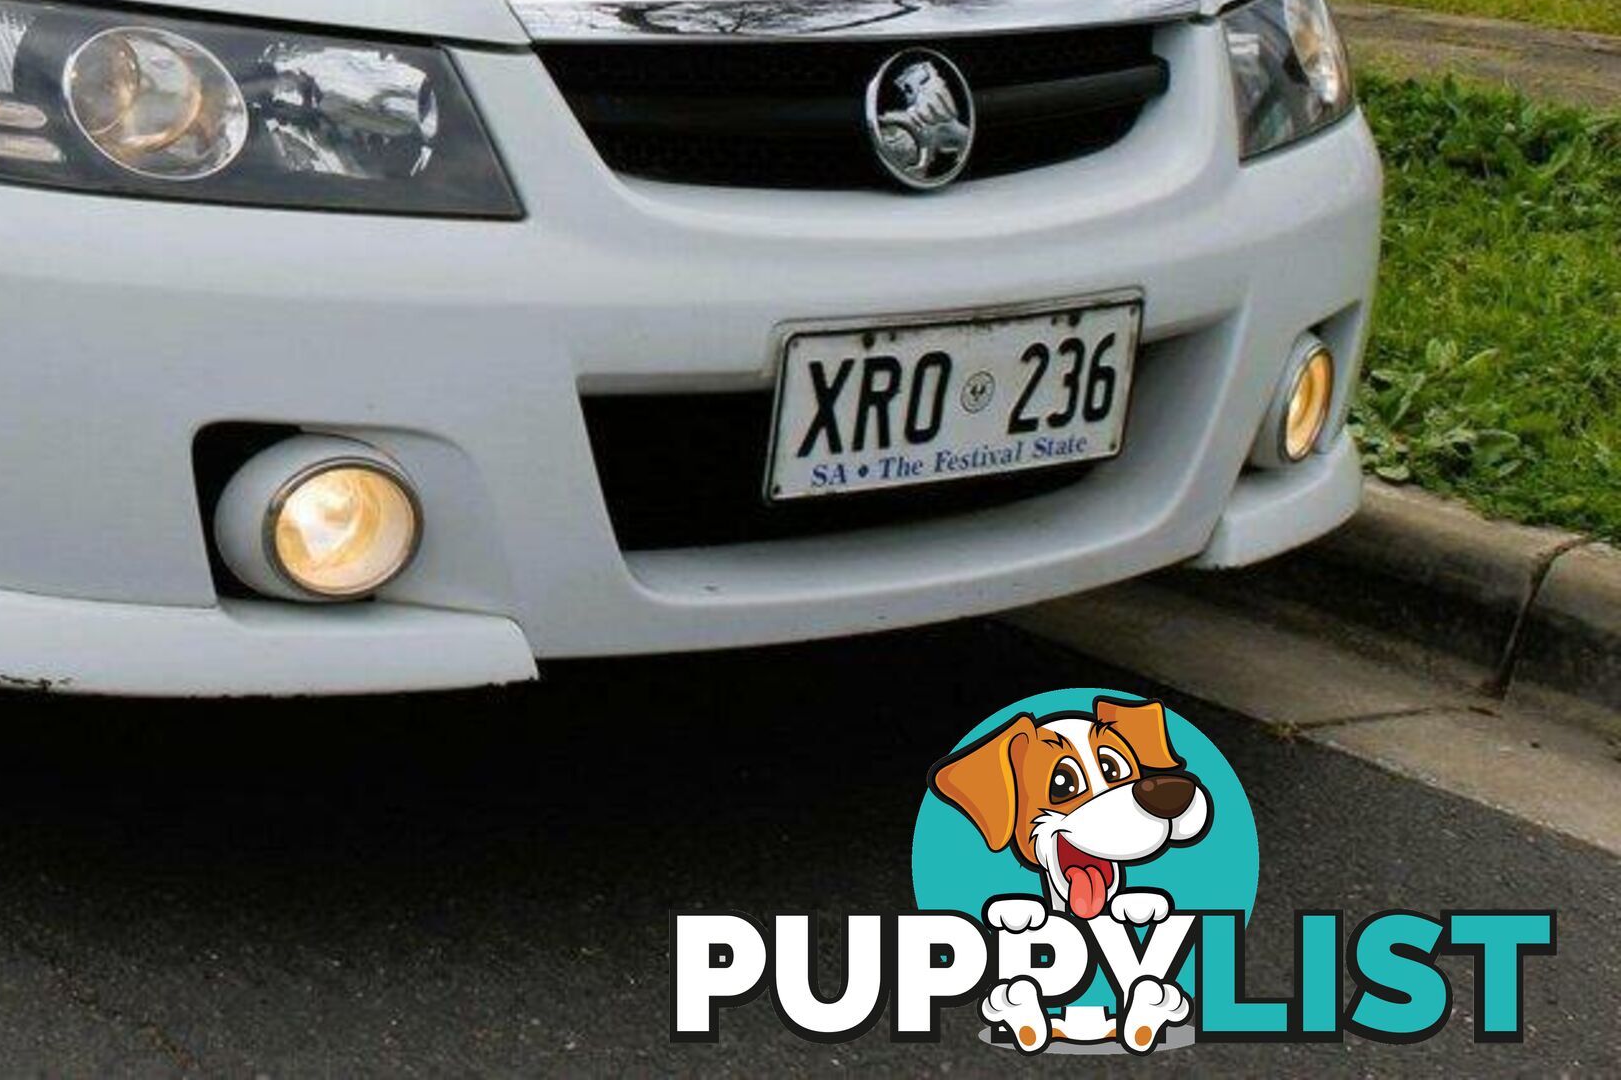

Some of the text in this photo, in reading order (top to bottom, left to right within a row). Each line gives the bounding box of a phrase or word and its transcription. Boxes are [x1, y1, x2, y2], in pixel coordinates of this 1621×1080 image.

[796, 332, 1117, 457] XRO 236
[810, 433, 1089, 488] SA The Festival State
